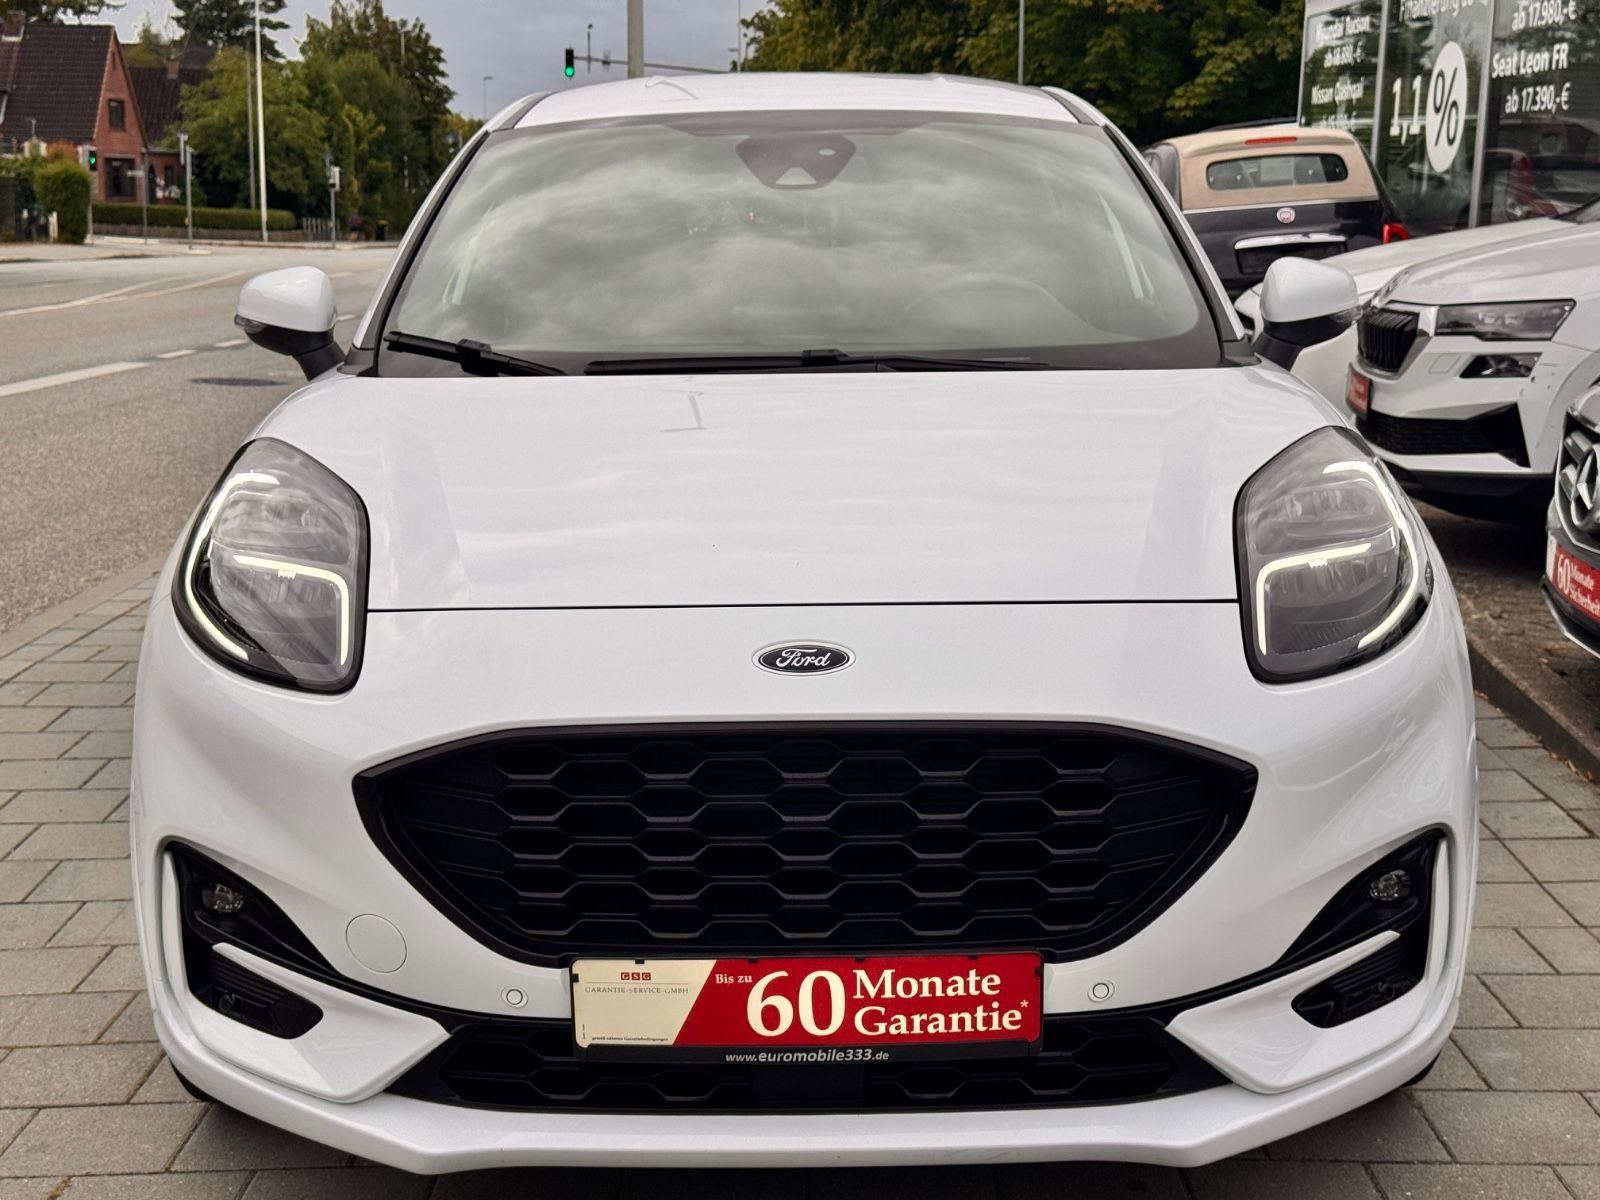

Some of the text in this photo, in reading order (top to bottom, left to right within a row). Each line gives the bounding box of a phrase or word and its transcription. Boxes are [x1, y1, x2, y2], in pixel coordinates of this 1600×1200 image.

[1512, 2, 1526, 30] ab
[1491, 42, 1569, 79] Seat Leon FR
[1389, 74, 1422, 146] 1,1
[1505, 87, 1519, 114] ab
[1557, 553, 1571, 595] 60
[775, 648, 831, 668] Ford
[621, 971, 651, 981] GSG
[715, 973, 752, 984] Bis zu
[852, 968, 1001, 1000] Monate
[746, 969, 846, 1037] 60
[725, 1048, 890, 1062] www.euromobile333.de
